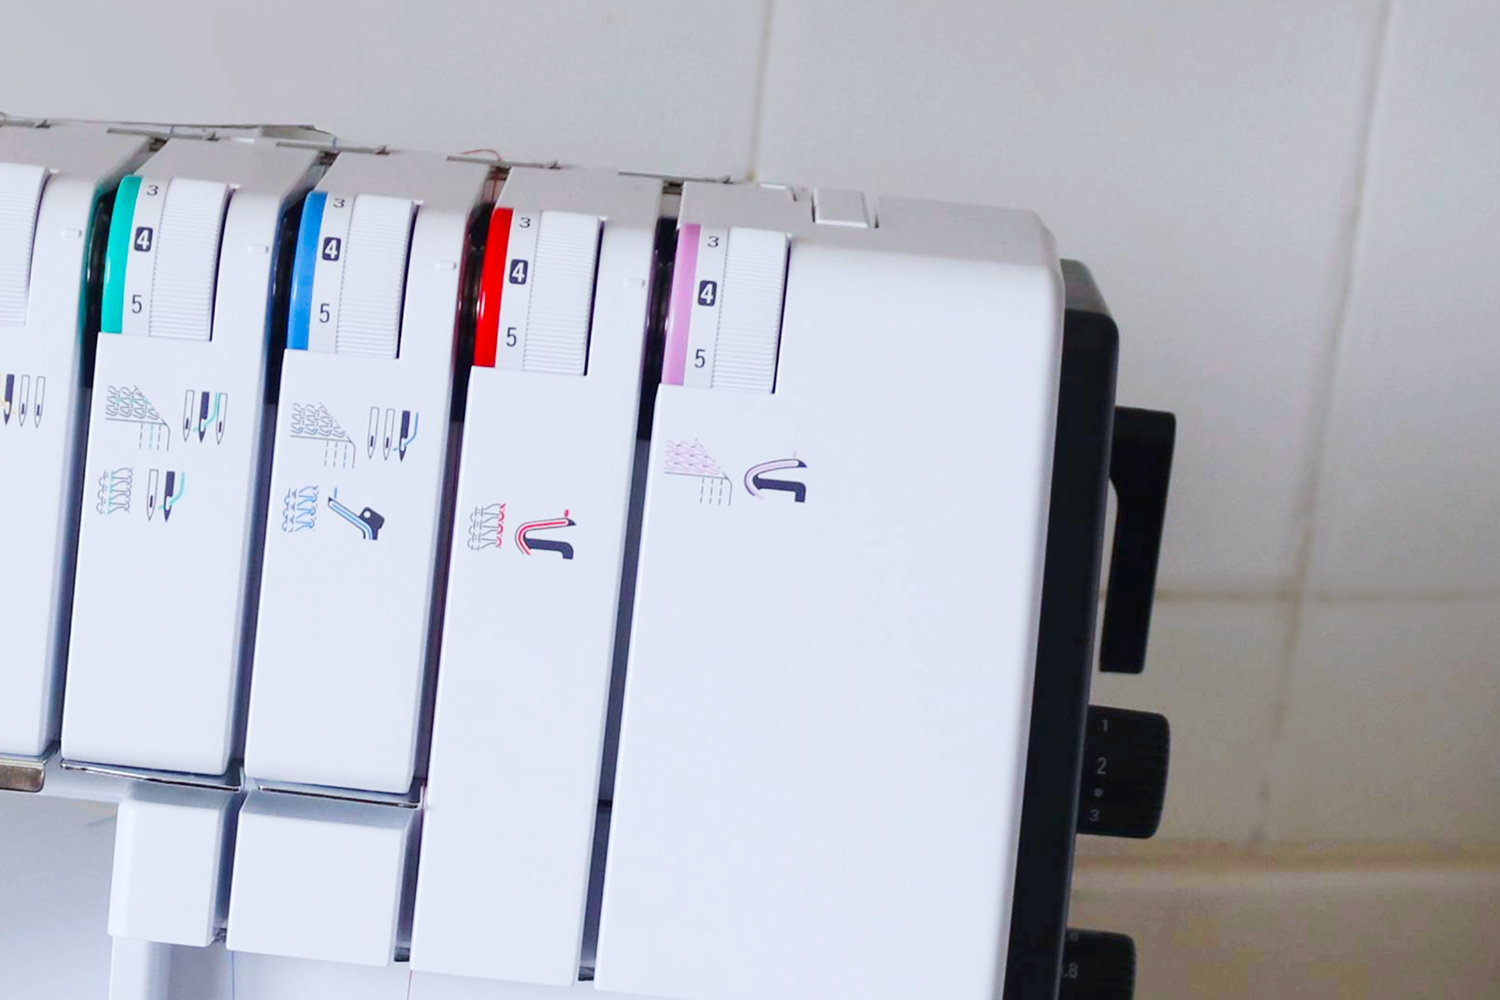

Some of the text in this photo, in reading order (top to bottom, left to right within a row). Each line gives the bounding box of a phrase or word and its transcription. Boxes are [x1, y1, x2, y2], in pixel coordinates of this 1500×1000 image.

[147, 185, 158, 195] 3
[334, 198, 345, 207] 3
[520, 218, 530, 228] 3
[137, 229, 150, 250] 4
[325, 238, 338, 259] 4
[708, 236, 719, 247] 3
[512, 263, 525, 284] 4
[701, 282, 714, 305] 4
[132, 295, 142, 313] 5
[320, 303, 329, 323] 5
[507, 327, 516, 347] 5
[695, 349, 705, 368] 5
[1102, 719, 1109, 732] 1
[1097, 757, 1107, 775] 2
[1088, 809, 1101, 822] 3
